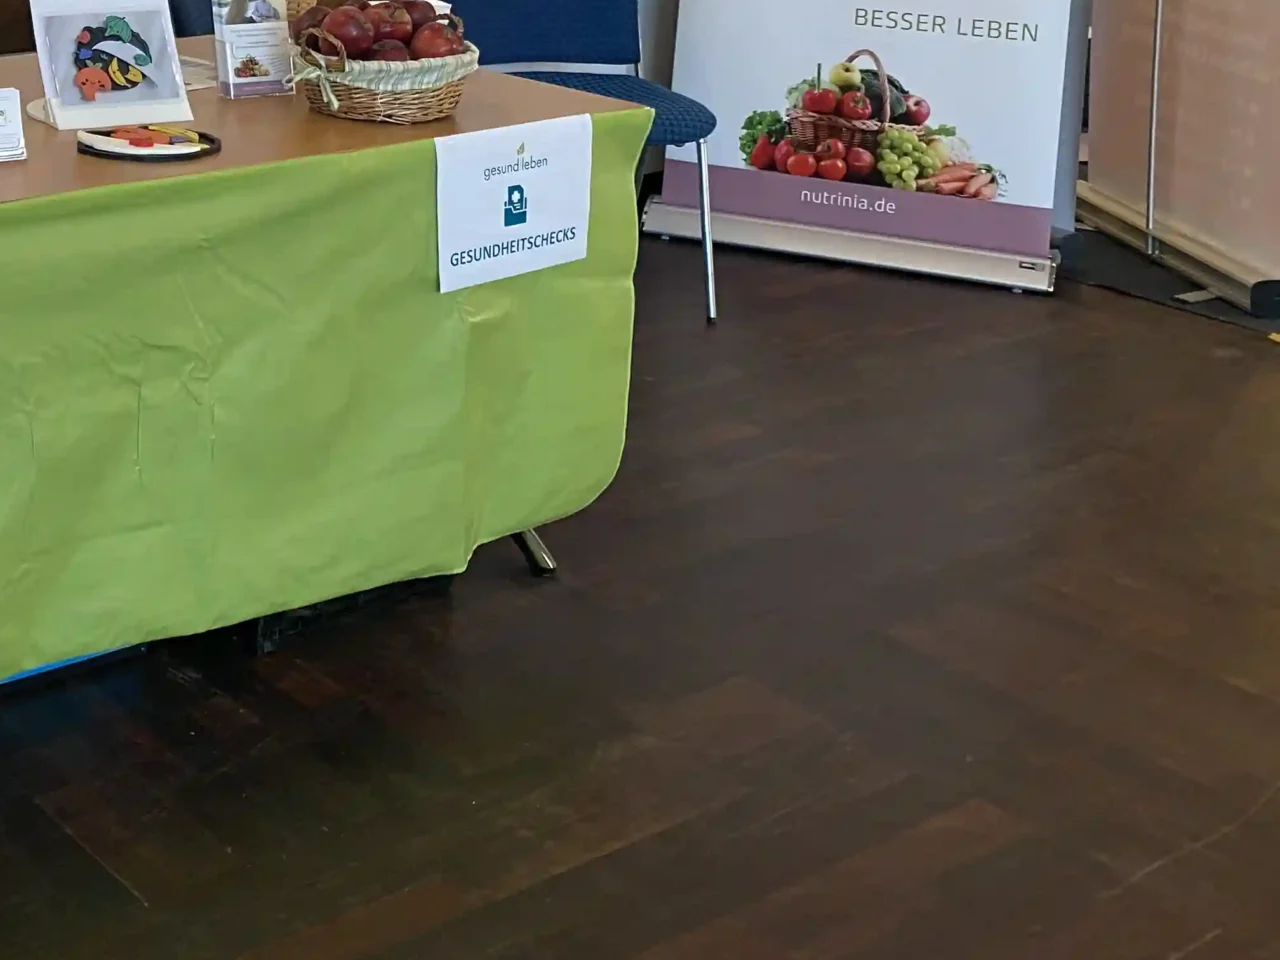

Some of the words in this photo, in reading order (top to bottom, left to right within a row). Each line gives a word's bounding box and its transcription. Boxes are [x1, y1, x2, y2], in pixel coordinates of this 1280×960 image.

[854, 7, 947, 34] BESSER
[956, 16, 1040, 43] LEBEN
[483, 157, 520, 182] gesund
[521, 155, 548, 170] leben
[799, 187, 897, 215] nutrinia.de
[450, 226, 577, 267] GESUNDHEITSCHECKS
